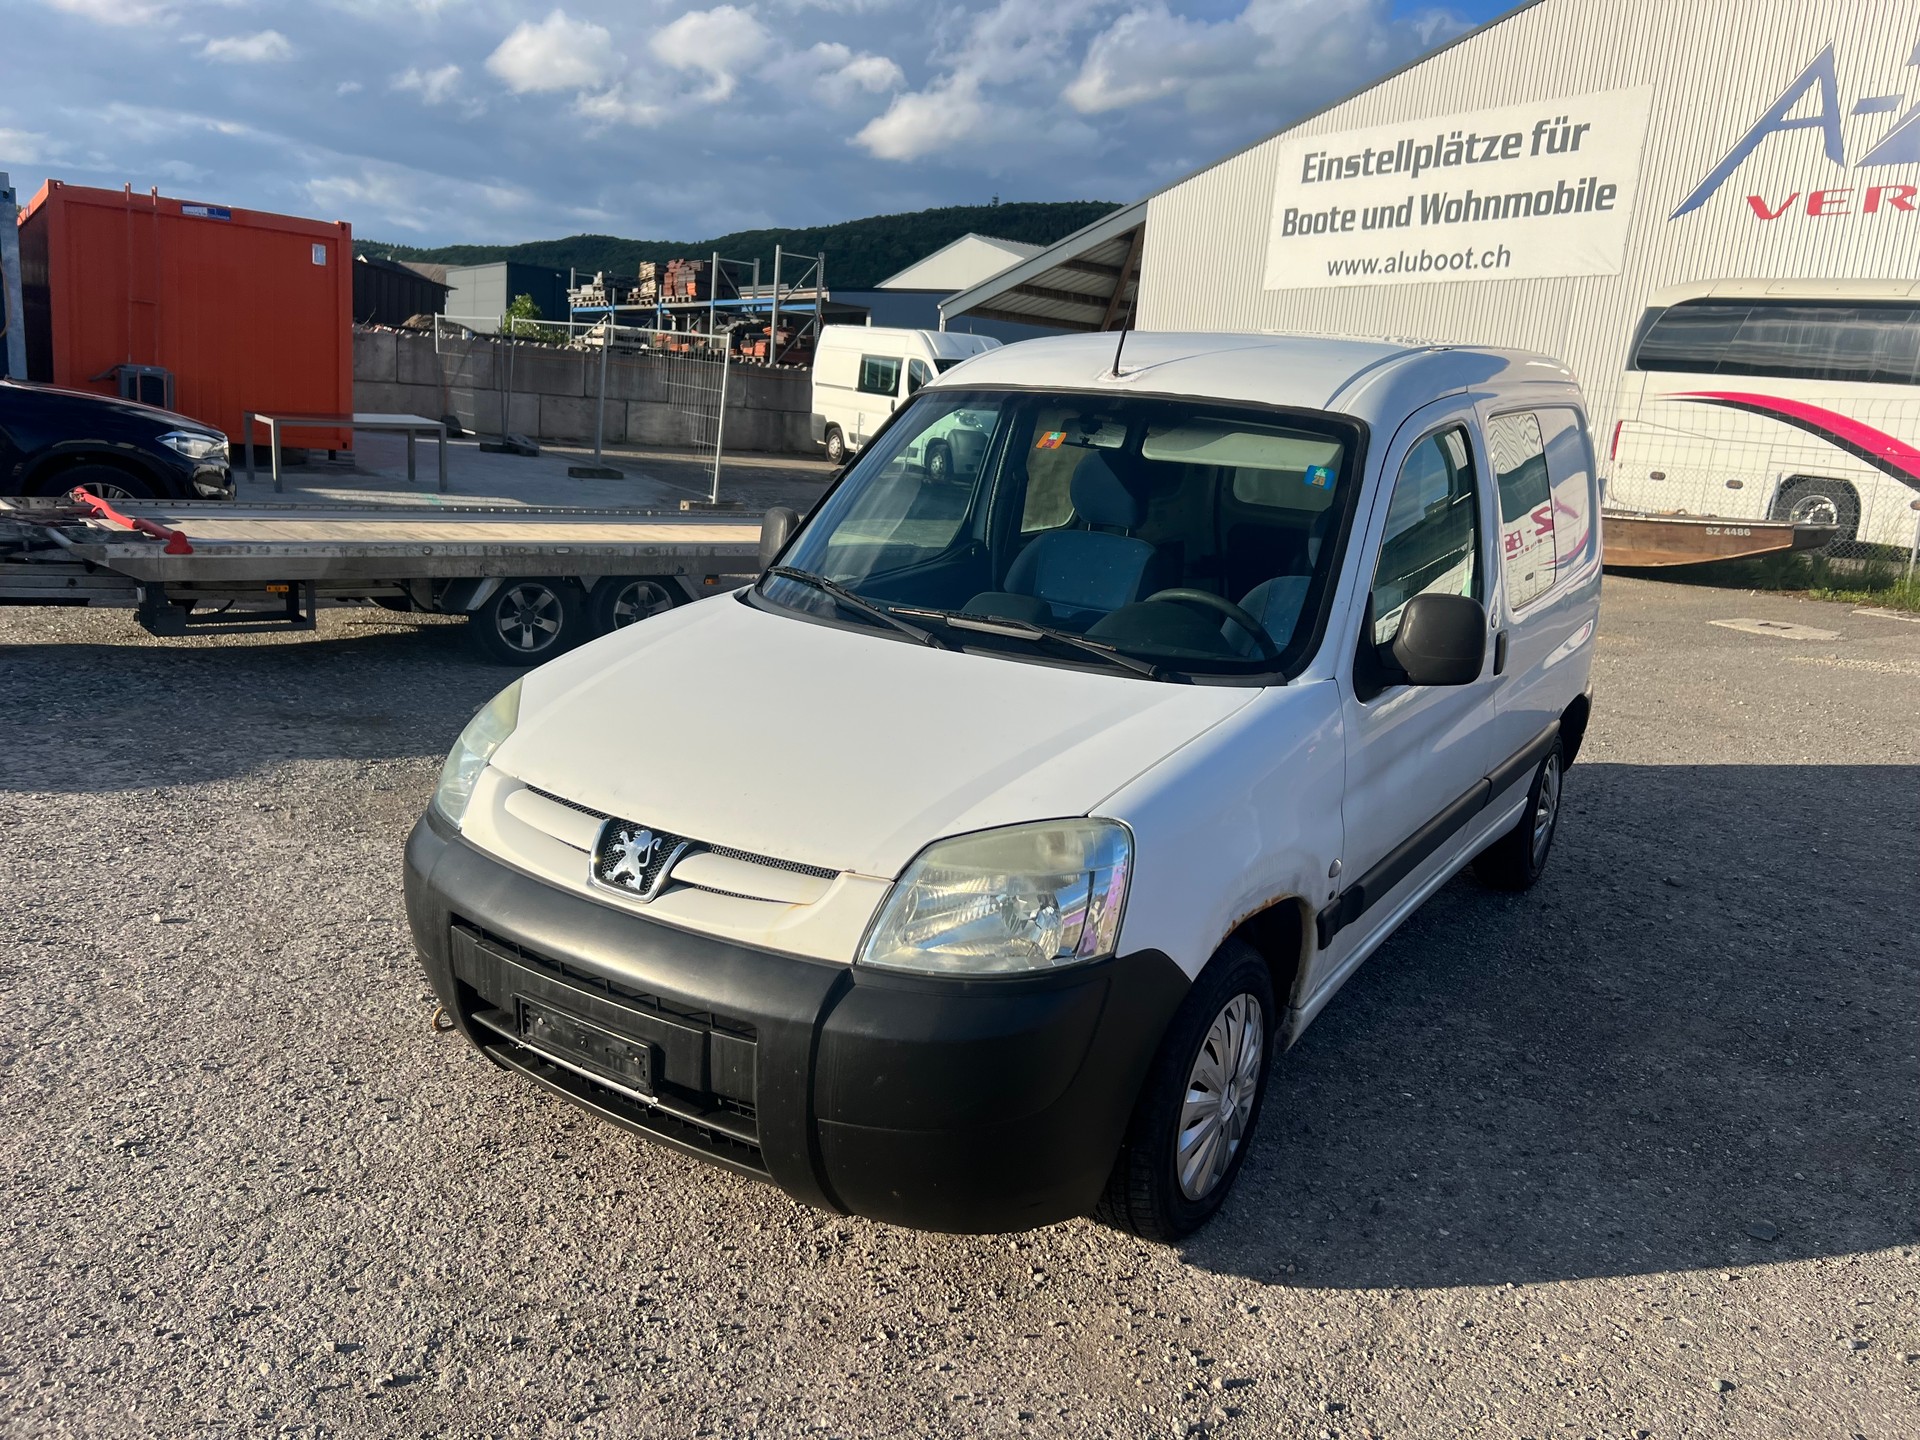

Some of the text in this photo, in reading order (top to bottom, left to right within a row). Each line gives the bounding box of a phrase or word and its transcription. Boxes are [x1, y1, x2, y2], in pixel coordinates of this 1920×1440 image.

[1301, 115, 1591, 184] Einstellplätze für
[1281, 177, 1617, 237] Boote und Wohnmobile
[1746, 185, 1918, 220] VER
[1327, 244, 1511, 277] www.aluboot.ch
[1705, 526, 1751, 537] SZ 4486
